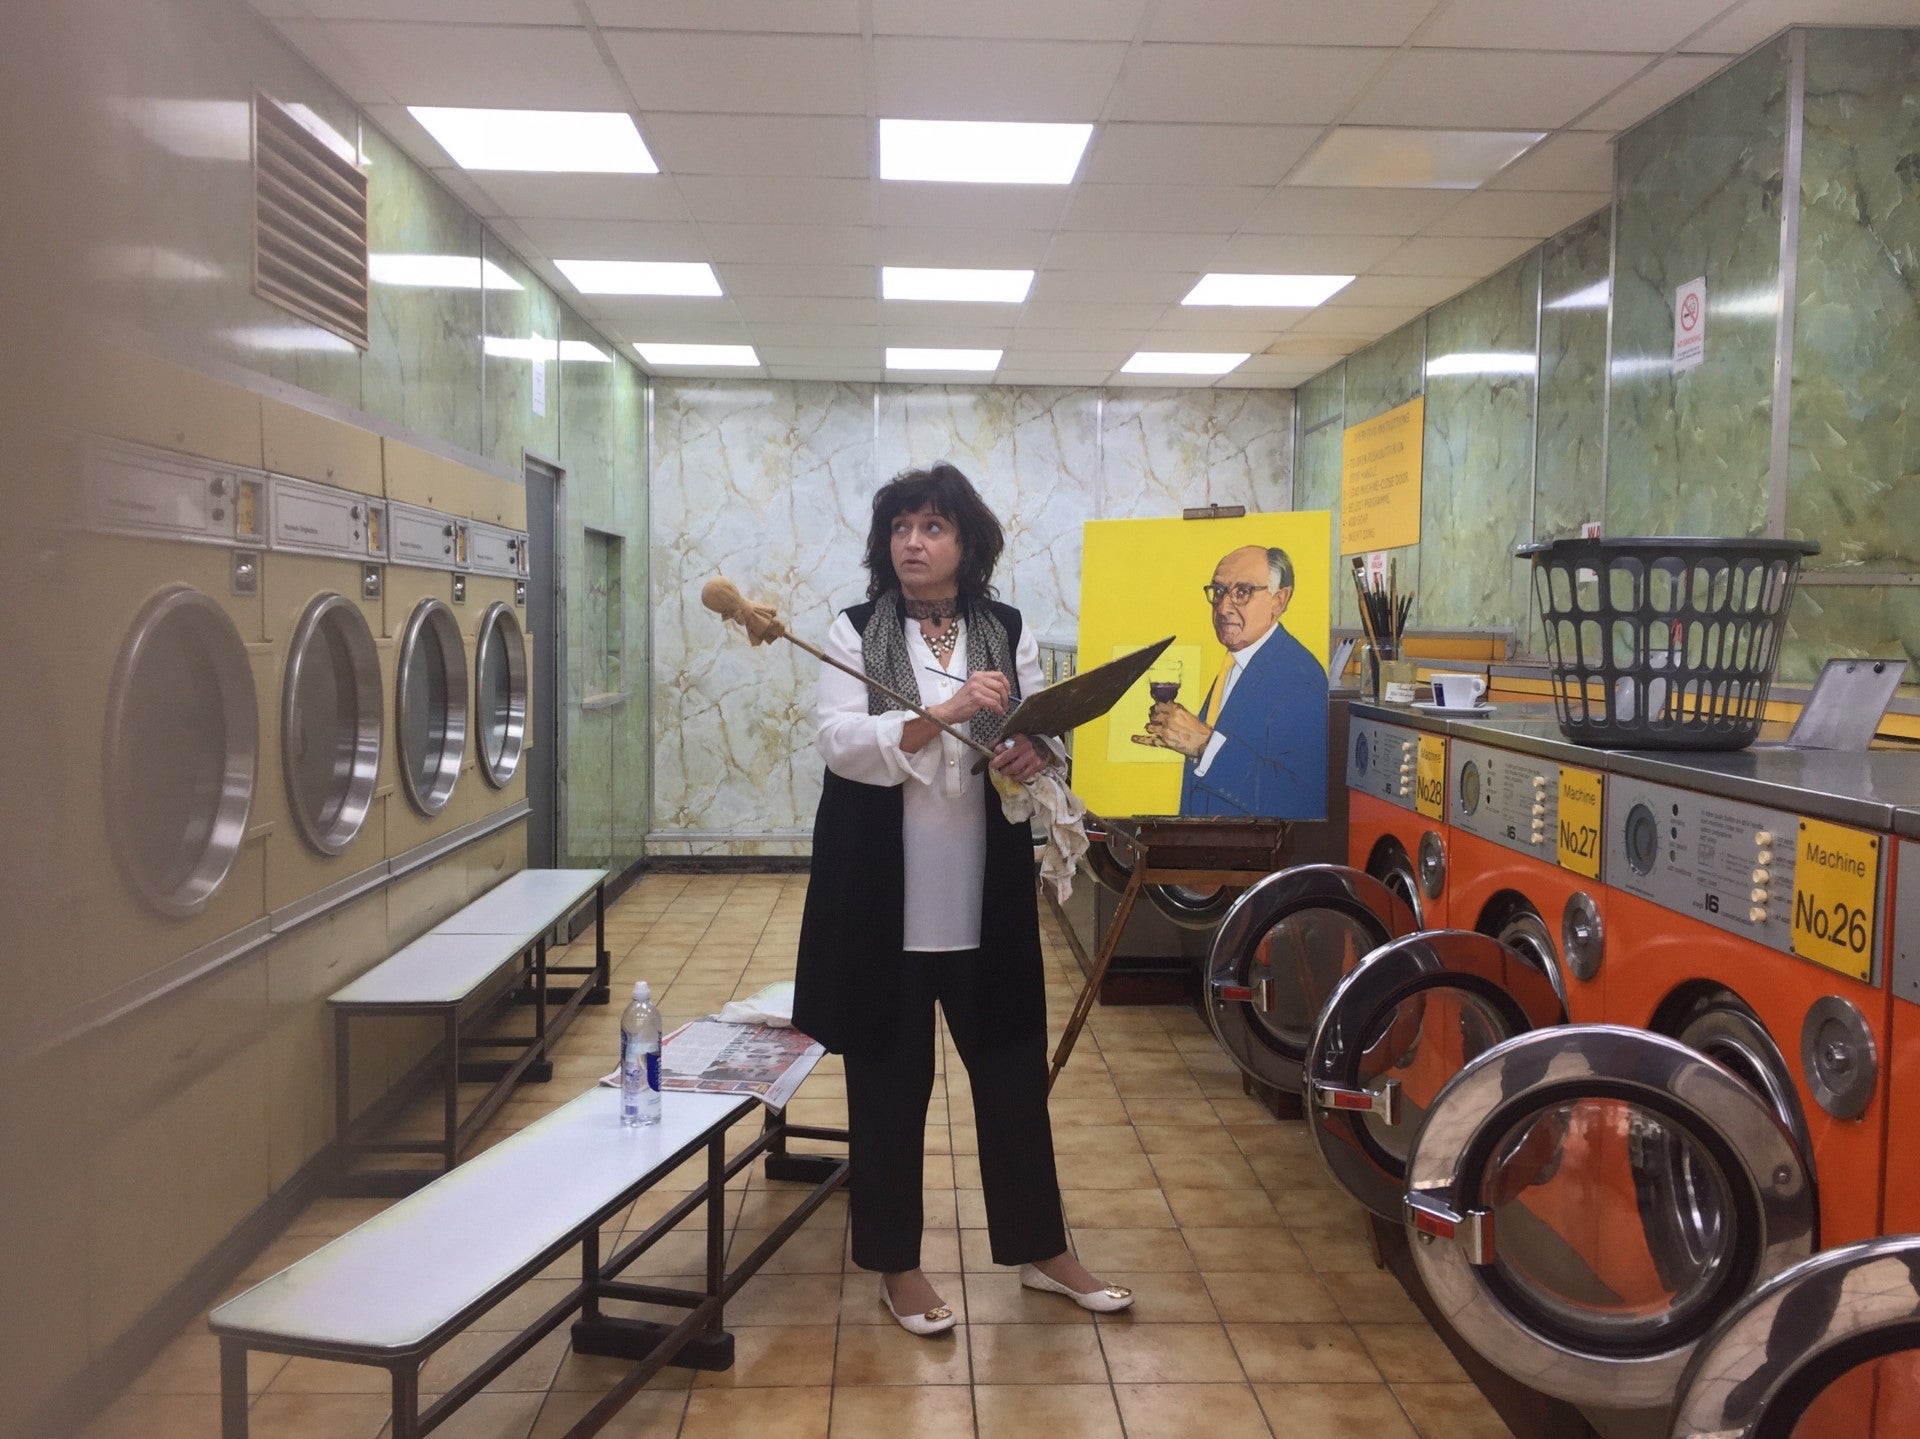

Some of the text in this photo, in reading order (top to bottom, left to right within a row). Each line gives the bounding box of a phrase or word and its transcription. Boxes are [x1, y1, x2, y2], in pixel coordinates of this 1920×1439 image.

[1420, 747, 1442, 763] Machine
[1563, 784, 1596, 806] Machine
[1507, 825, 1516, 840] 16
[1560, 819, 1598, 859] No.27
[1806, 842, 1866, 878] Machine
[1705, 893, 1719, 914] 16
[1795, 889, 1867, 954] No.26
